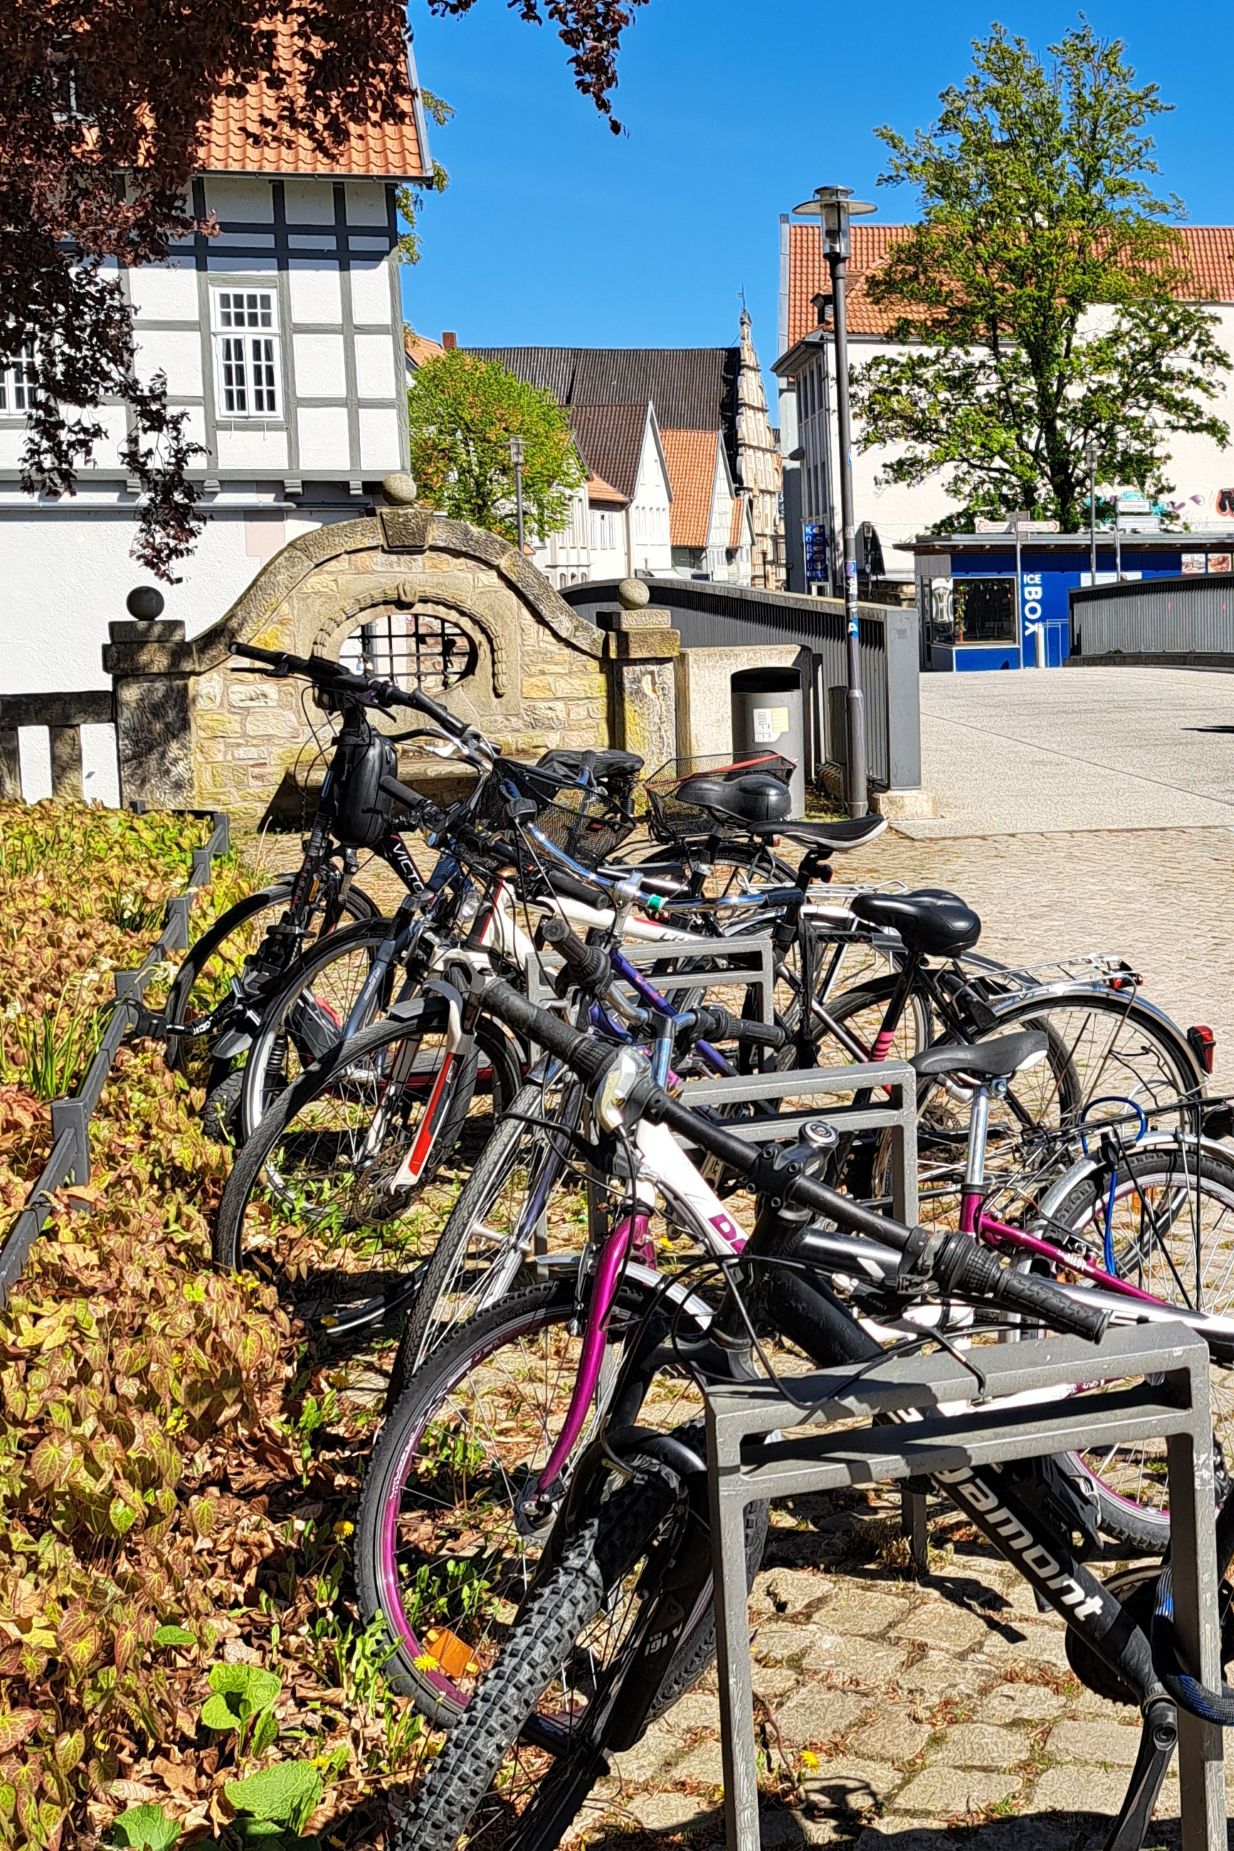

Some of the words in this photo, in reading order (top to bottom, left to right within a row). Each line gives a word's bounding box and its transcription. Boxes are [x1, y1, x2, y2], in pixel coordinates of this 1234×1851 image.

[1023, 573, 1042, 585] ICE
[1024, 586, 1043, 637] BOX
[935, 1467, 1105, 1622] amont
